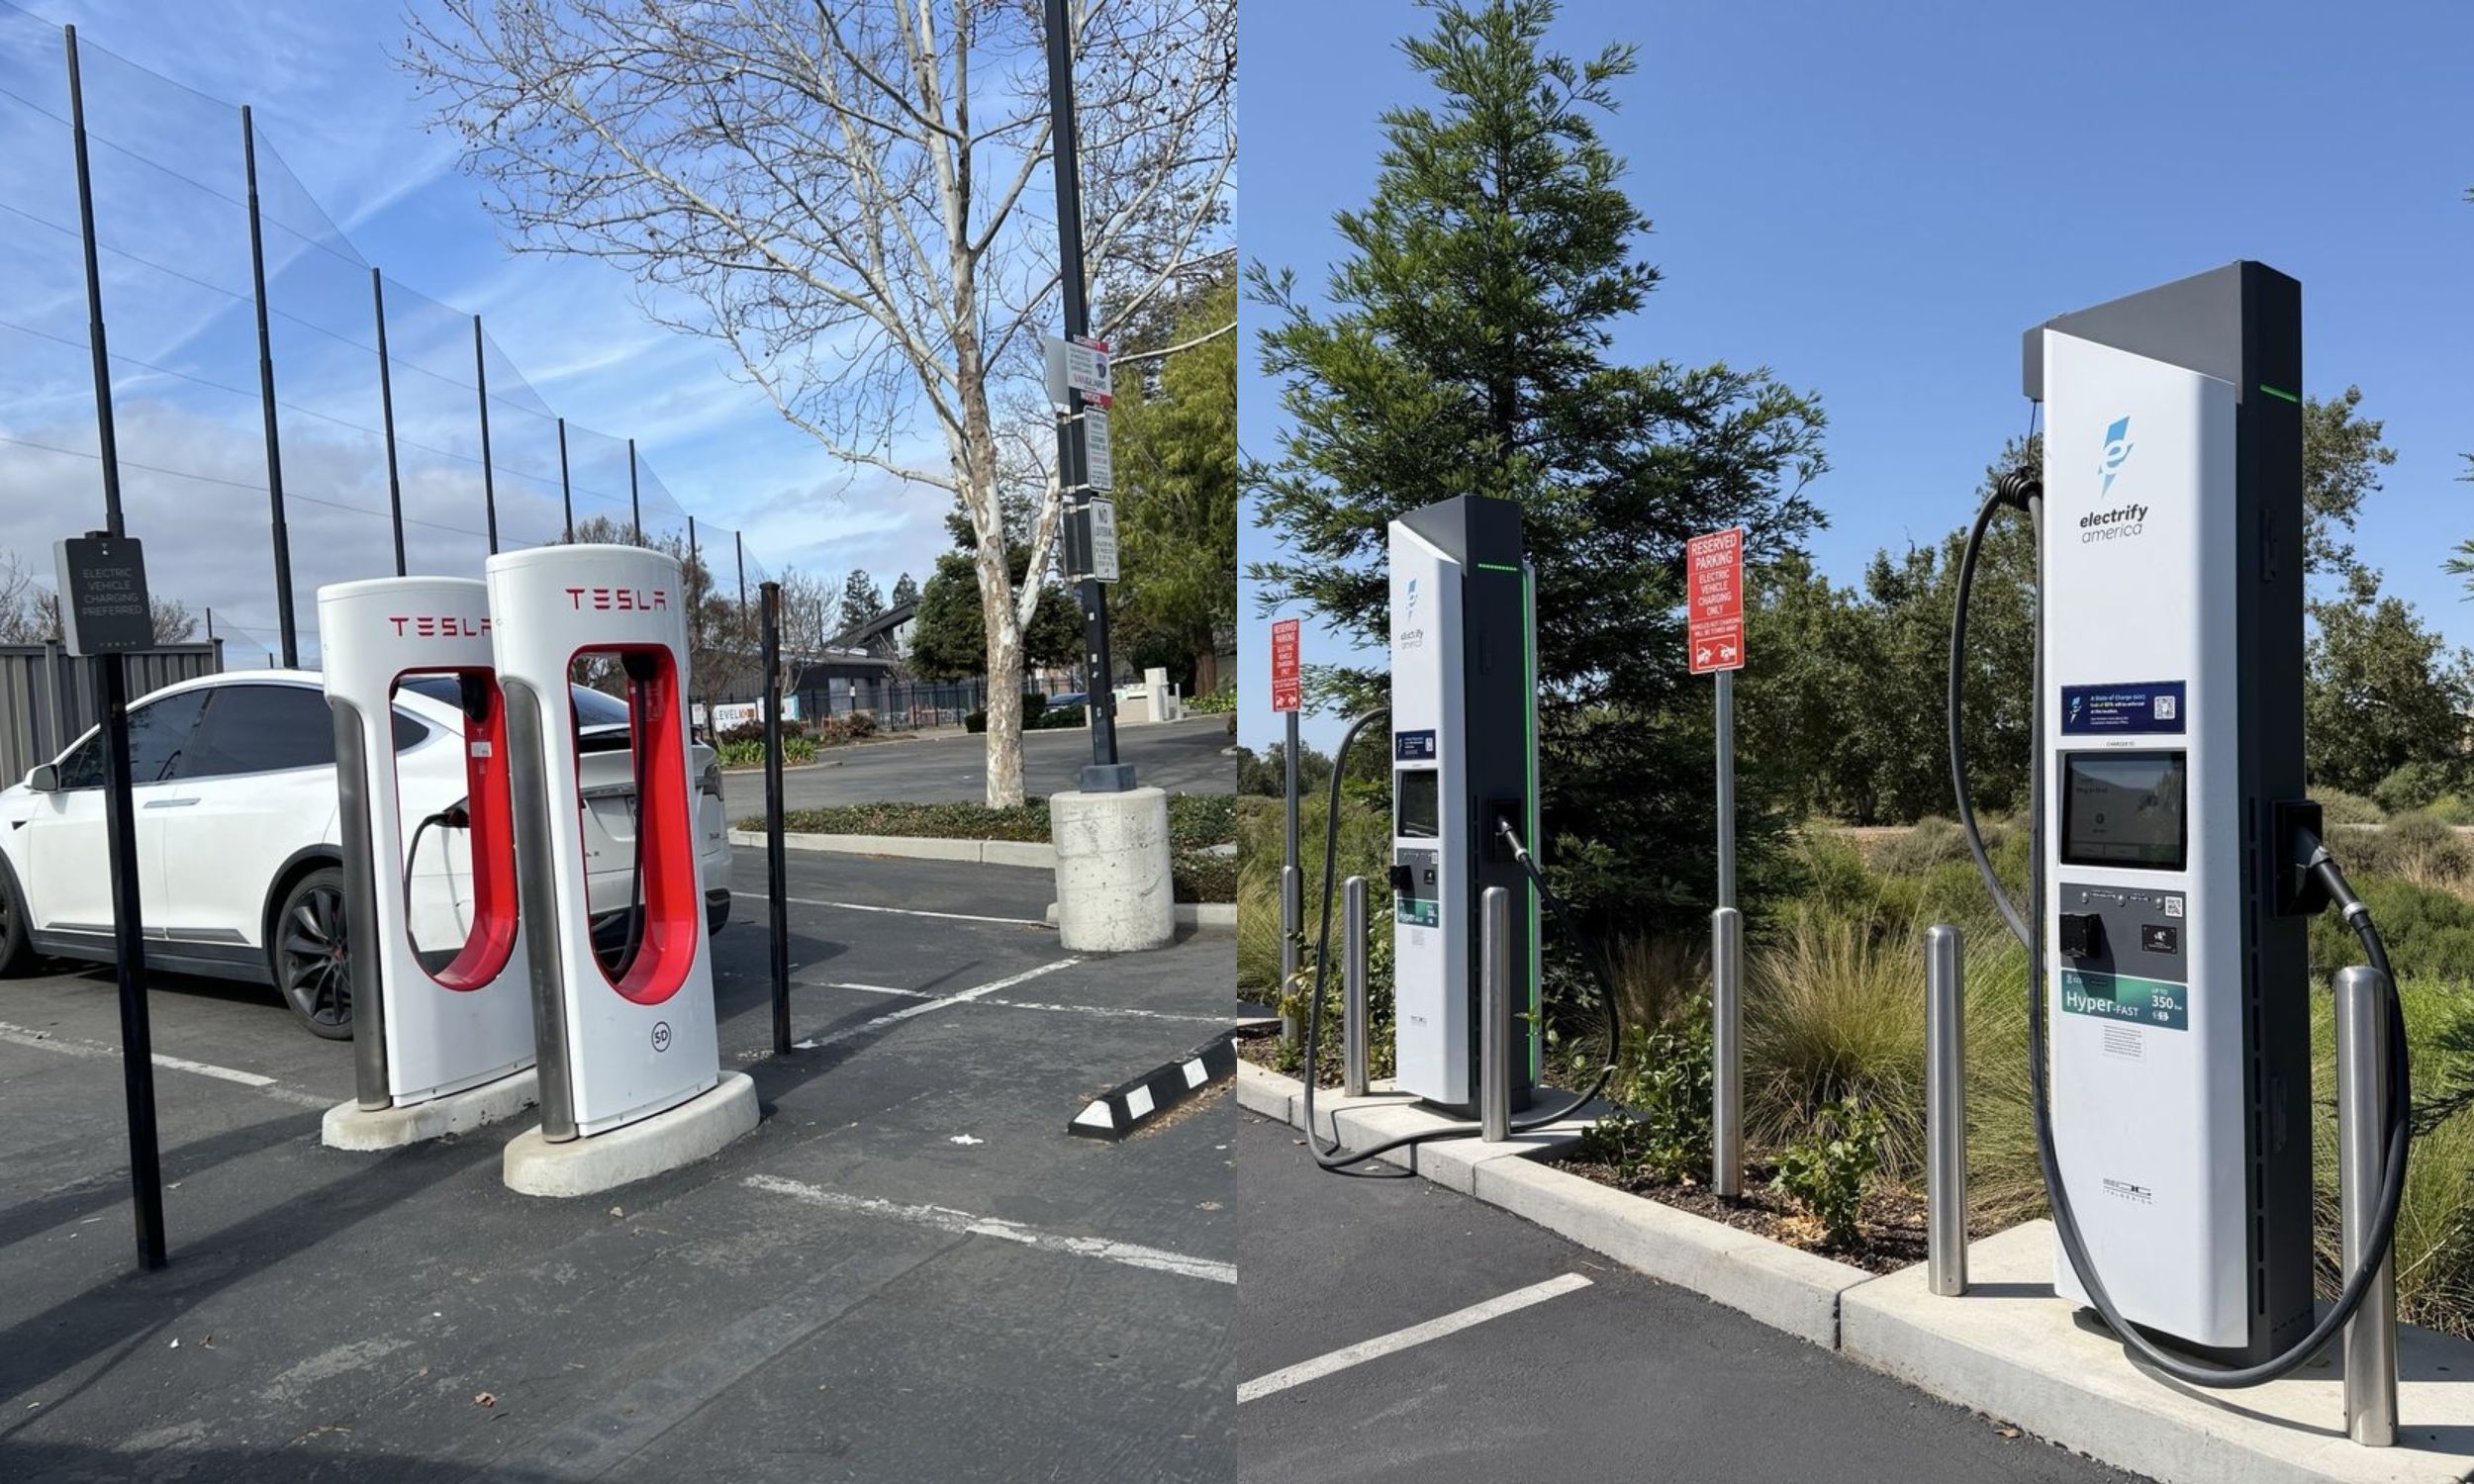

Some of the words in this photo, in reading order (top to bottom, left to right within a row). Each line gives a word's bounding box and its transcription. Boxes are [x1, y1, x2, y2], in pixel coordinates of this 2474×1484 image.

[1097, 506, 1108, 524] NO
[2079, 504, 2148, 528] electrify
[2081, 522, 2142, 544] america
[1691, 534, 1737, 557] RESERVED
[1695, 550, 1733, 571] PARKING
[83, 568, 133, 579] ELECTRIC
[1699, 569, 1730, 585] ELECTRIC
[87, 580, 132, 592] VEHICLE
[1700, 581, 1730, 595] VEHICLE
[83, 593, 139, 603] CHARGING
[566, 589, 667, 610] TESLA
[1697, 593, 1732, 606] CHARGING
[81, 604, 143, 617] PREFERRED
[1707, 604, 1724, 616] ONLY
[389, 616, 492, 637] TESLA
[2151, 994, 2174, 1010] 350
[654, 1029, 669, 1044] 5D
